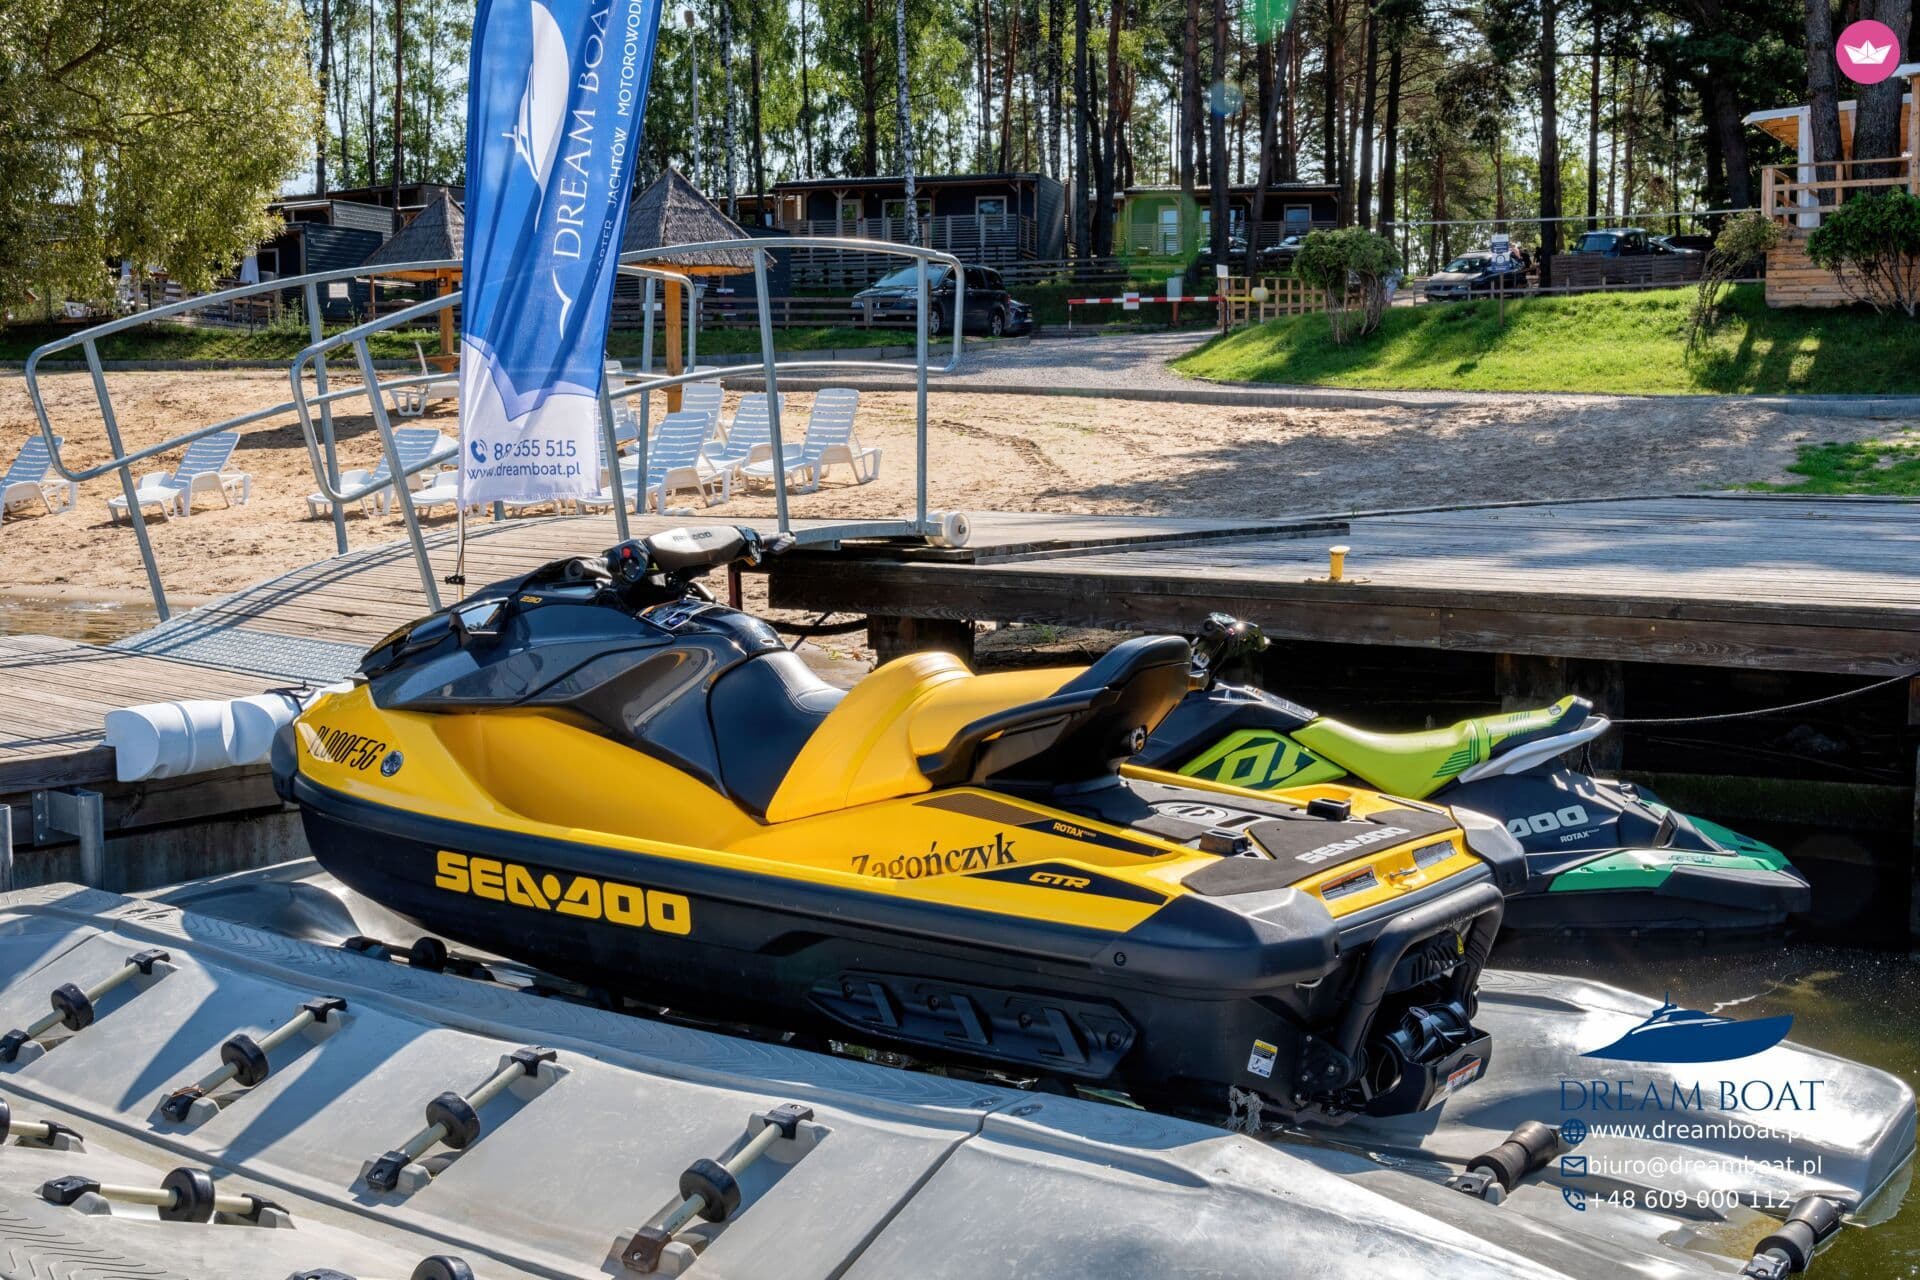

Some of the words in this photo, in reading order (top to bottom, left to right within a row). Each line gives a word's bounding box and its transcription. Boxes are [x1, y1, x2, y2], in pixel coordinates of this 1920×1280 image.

[553, 109, 597, 259] DREAM
[578, 0, 609, 94] BOA
[607, 127, 627, 208] JACHTÓW
[545, 439, 576, 457] 515
[467, 461, 581, 480] www.dreamboat.pl
[1053, 821, 1083, 838] ROTAX
[1560, 830, 1590, 843] ROTAX
[850, 832, 1017, 880] Zagończyk
[1028, 871, 1091, 890] GTR
